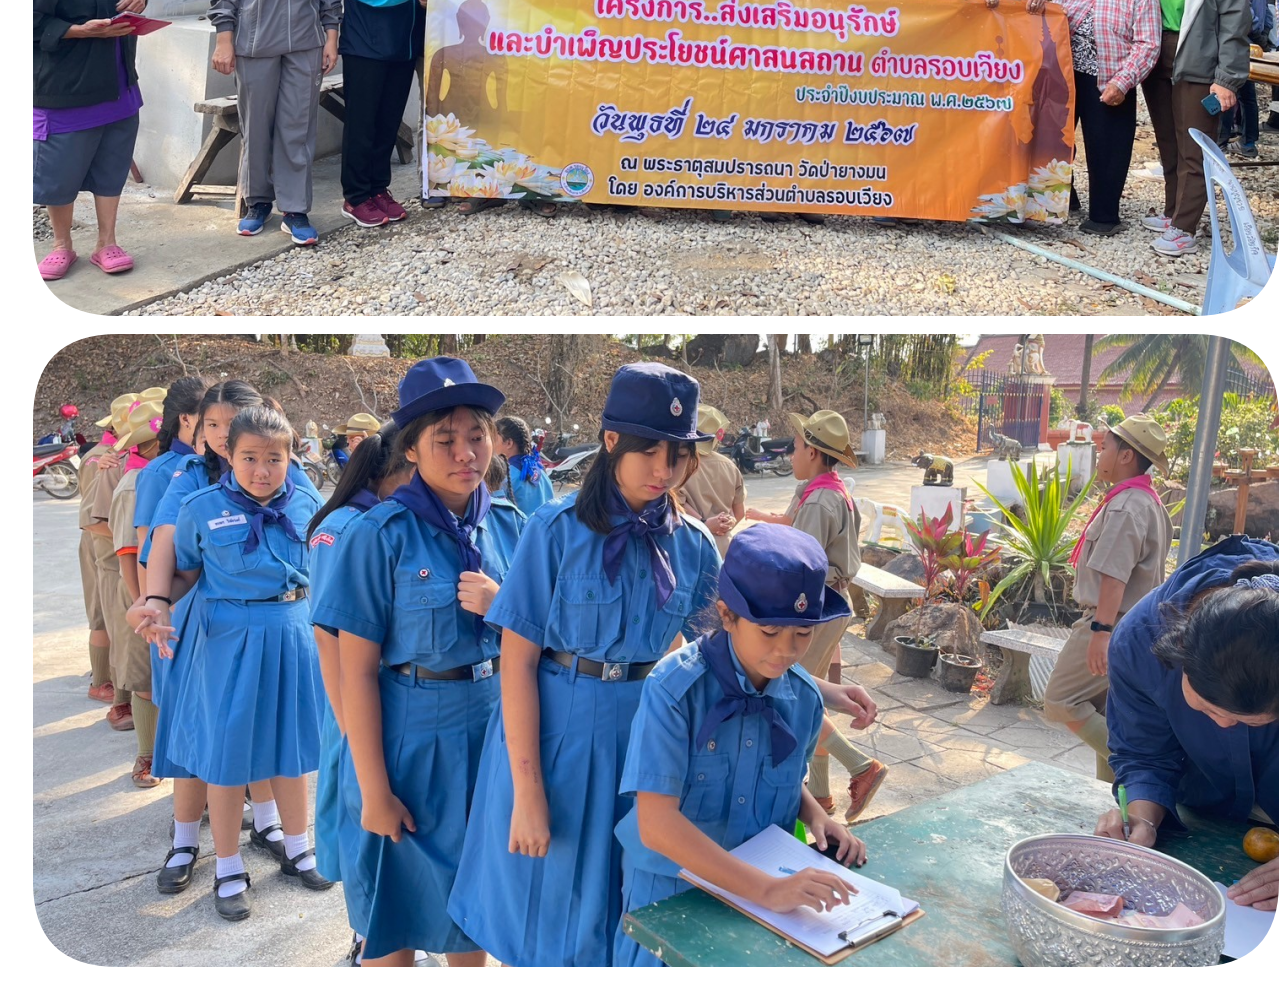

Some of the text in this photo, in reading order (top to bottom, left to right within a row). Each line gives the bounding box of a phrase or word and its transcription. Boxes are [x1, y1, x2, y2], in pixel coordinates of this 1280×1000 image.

[489, 28, 1021, 81] และบำเพ็ญประโยชน์ศาสนสถาน ตำบลรอบเวียง
[796, 84, 1013, 111] ประจำปีงบประมาณ พ.ศ.๒๕๖๗
[593, 99, 692, 141] วันพุธที่
[695, 114, 738, 137] ๒๔
[621, 157, 886, 180] ณ พระธาตุสมปรารถนา วัดป่ายางมน
[609, 177, 638, 196] โดย
[643, 178, 893, 207] องค์การบริหารส่วนตำบลรอบเวียง
